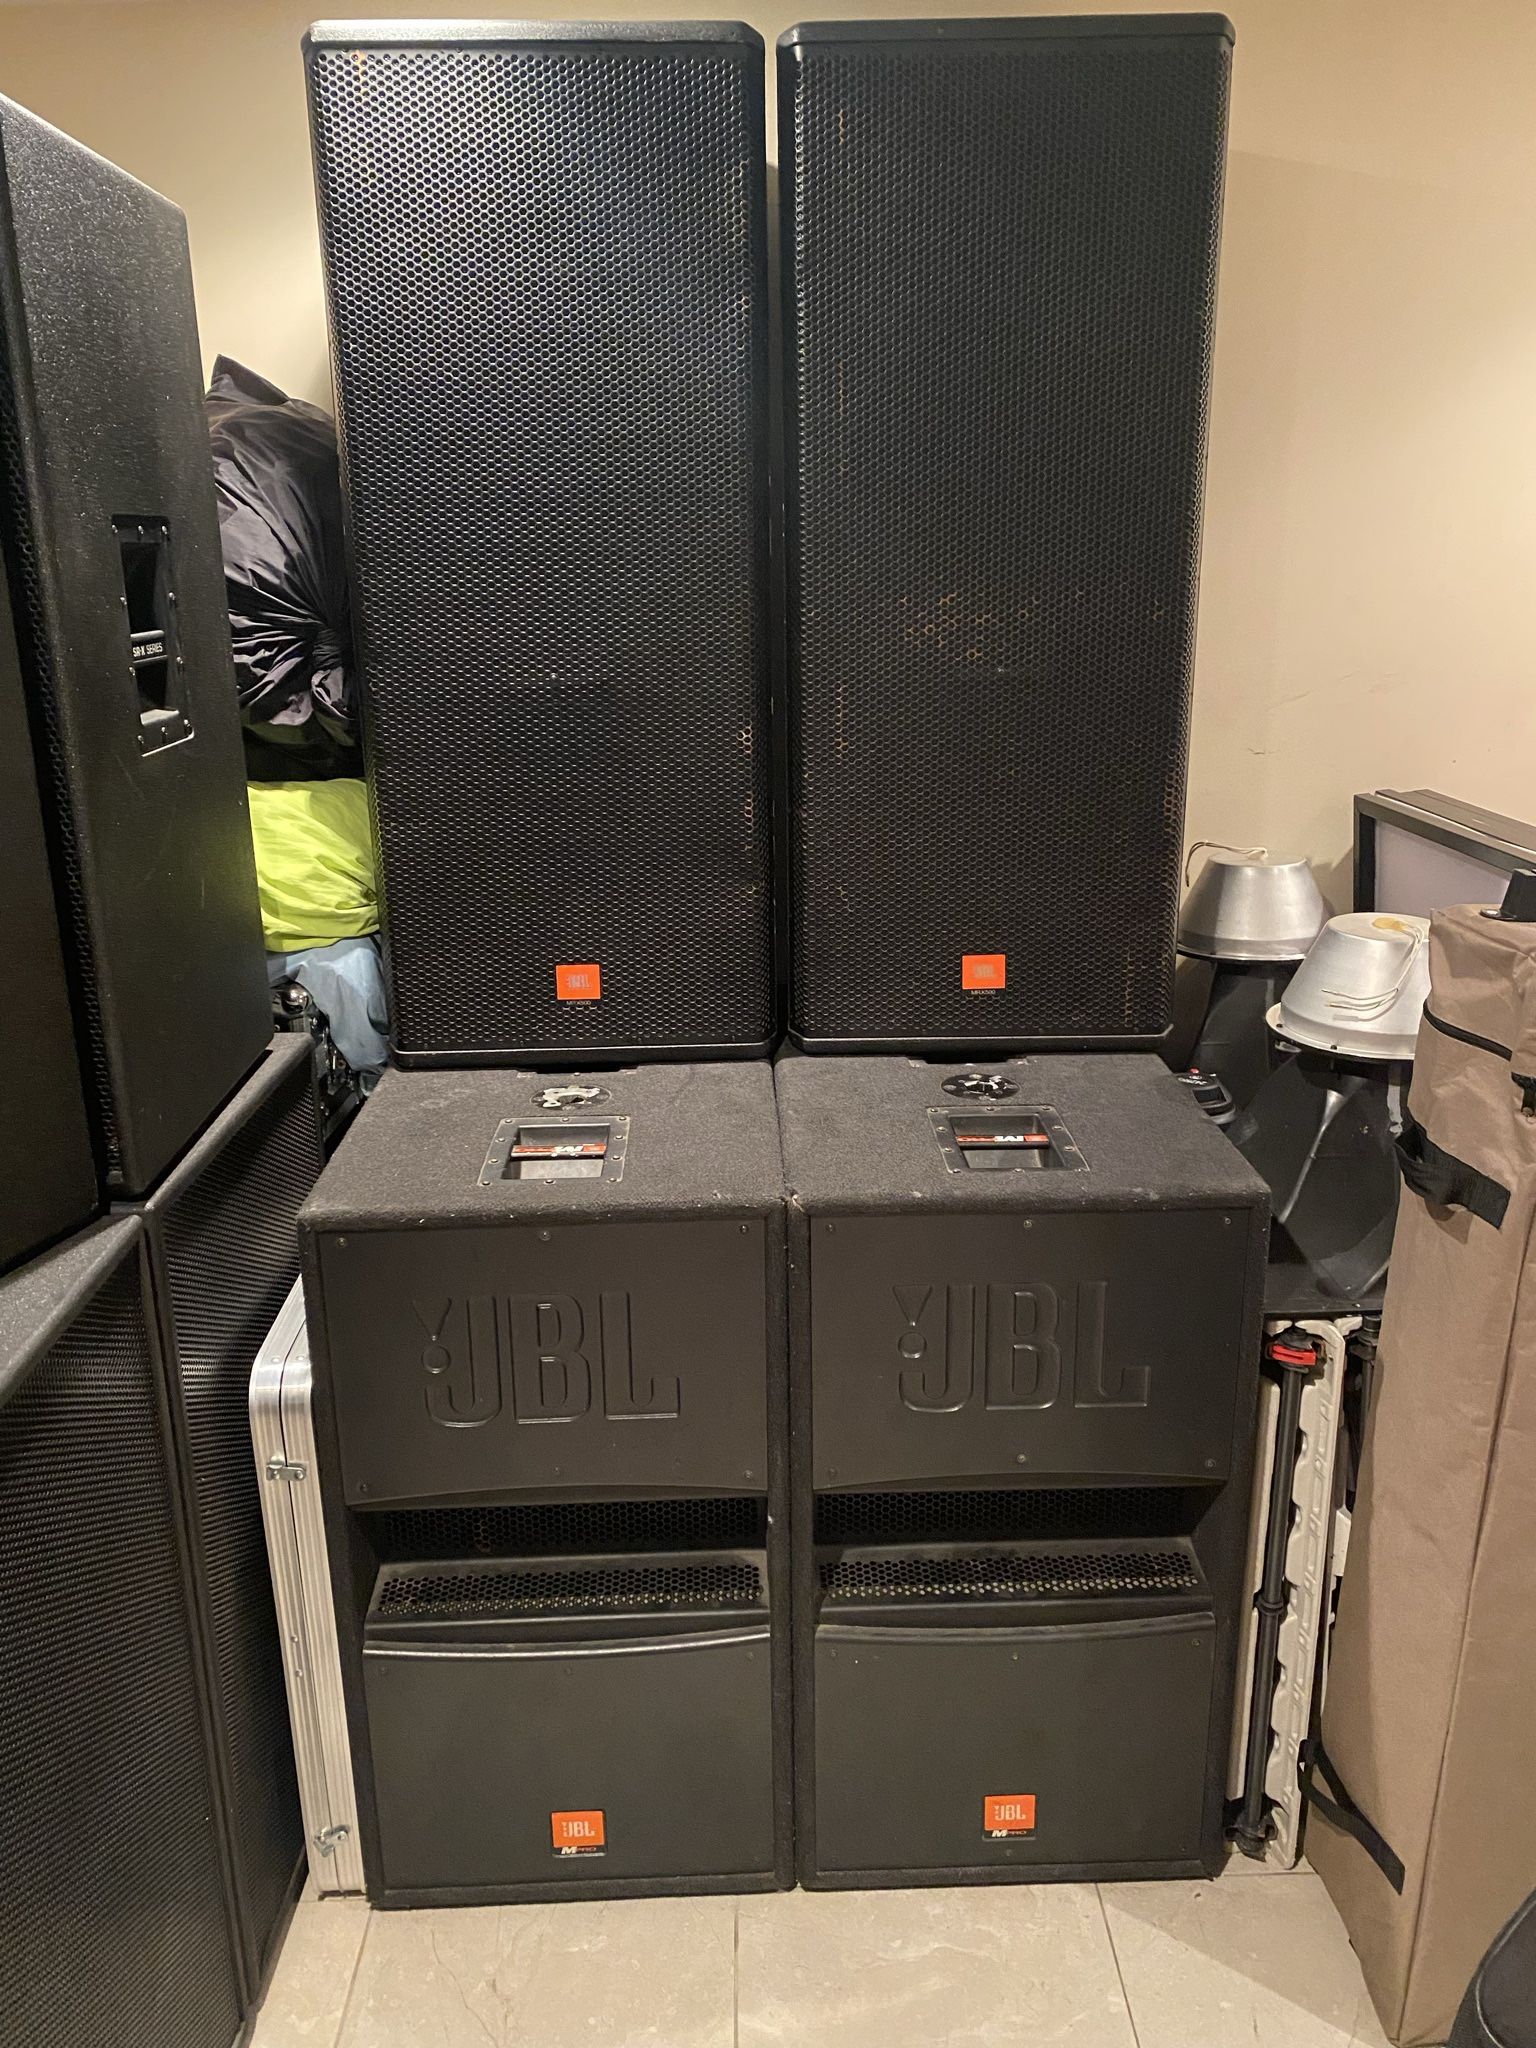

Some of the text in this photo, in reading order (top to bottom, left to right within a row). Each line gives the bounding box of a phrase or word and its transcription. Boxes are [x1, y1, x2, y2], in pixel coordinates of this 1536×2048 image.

[132, 642, 163, 658] SR-X SERIES
[897, 1281, 1150, 1413] JBL
[422, 1291, 681, 1429] JBL
[994, 1804, 1026, 1821] JBL
[562, 1820, 596, 1838] JBL
